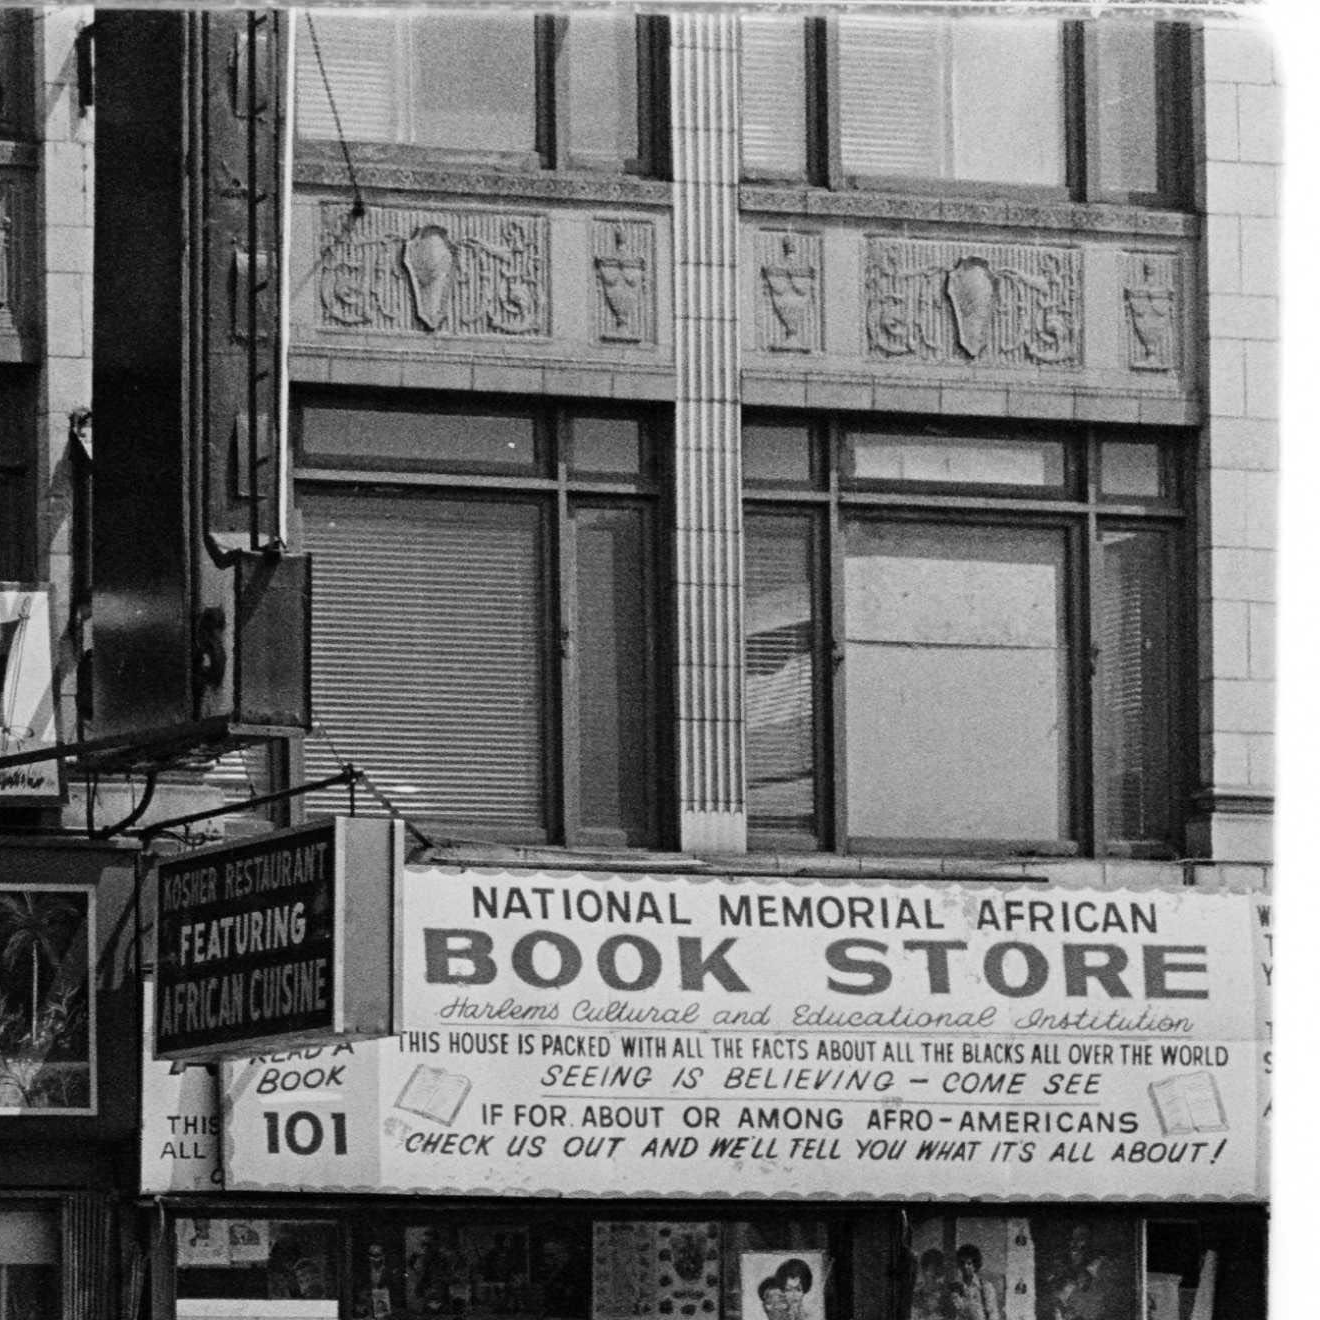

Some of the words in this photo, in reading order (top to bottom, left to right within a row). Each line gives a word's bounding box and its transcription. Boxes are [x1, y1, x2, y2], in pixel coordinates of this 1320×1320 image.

[163, 865, 217, 912] KOSHER
[225, 842, 328, 899] RESTAURANT
[472, 886, 692, 925] NATIONAL
[719, 893, 944, 931] MEMORIAL
[976, 899, 1158, 934] AFRICAN
[180, 901, 307, 966] FEATURING
[423, 928, 751, 993] BOOK
[825, 937, 1210, 1001] STORE
[162, 973, 244, 1036] AFRICAN
[249, 958, 328, 1022] CUISINE
[572, 999, 701, 1025] Cultural
[712, 1004, 771, 1027] and
[792, 1003, 997, 1029] Educational
[1015, 1004, 1195, 1033] Institution
[399, 1030, 440, 1054] THIS
[449, 1032, 509, 1056] HOUSE
[518, 1033, 535, 1057] IS
[541, 1034, 611, 1059] PACKED
[621, 1035, 667, 1059] WITH
[672, 1036, 704, 1060] ALL
[711, 1037, 744, 1060] THE
[752, 1037, 809, 1062] FACTS
[817, 1039, 876, 1063] ABOUT
[882, 1041, 914, 1064] ALL
[921, 1042, 954, 1065] THE
[963, 1043, 1026, 1066] BLACKS
[1031, 1044, 1062, 1066] ALL
[1068, 1044, 1114, 1067] OVER
[1121, 1044, 1153, 1067] THE
[1161, 1045, 1229, 1068] WORLD
[256, 1065, 346, 1095] BOOK
[541, 1065, 653, 1088] SEEING
[672, 1067, 704, 1089] IS
[724, 1068, 896, 1092] BELIEVING
[942, 1072, 1026, 1095] COME
[1043, 1073, 1102, 1095] SEE
[167, 1116, 220, 1136] THIS
[263, 1111, 347, 1155] 101
[482, 1103, 503, 1125] IF
[581, 1105, 664, 1128] ABOUT
[683, 1106, 720, 1129] OR
[738, 1106, 844, 1130] AMONG
[867, 1109, 1139, 1134] AFRO-AMERICANS
[160, 1142, 206, 1159] ALL
[405, 1132, 493, 1157] CHECK
[507, 1135, 546, 1158] US
[563, 1136, 626, 1158] OUT
[641, 1137, 699, 1158] AND
[790, 1138, 842, 1160] TELL
[855, 1139, 905, 1161] YOU
[916, 1140, 981, 1162] WHAT
[1049, 1142, 1095, 1164] ALL
[1111, 1139, 1228, 1165] ABOUT!
